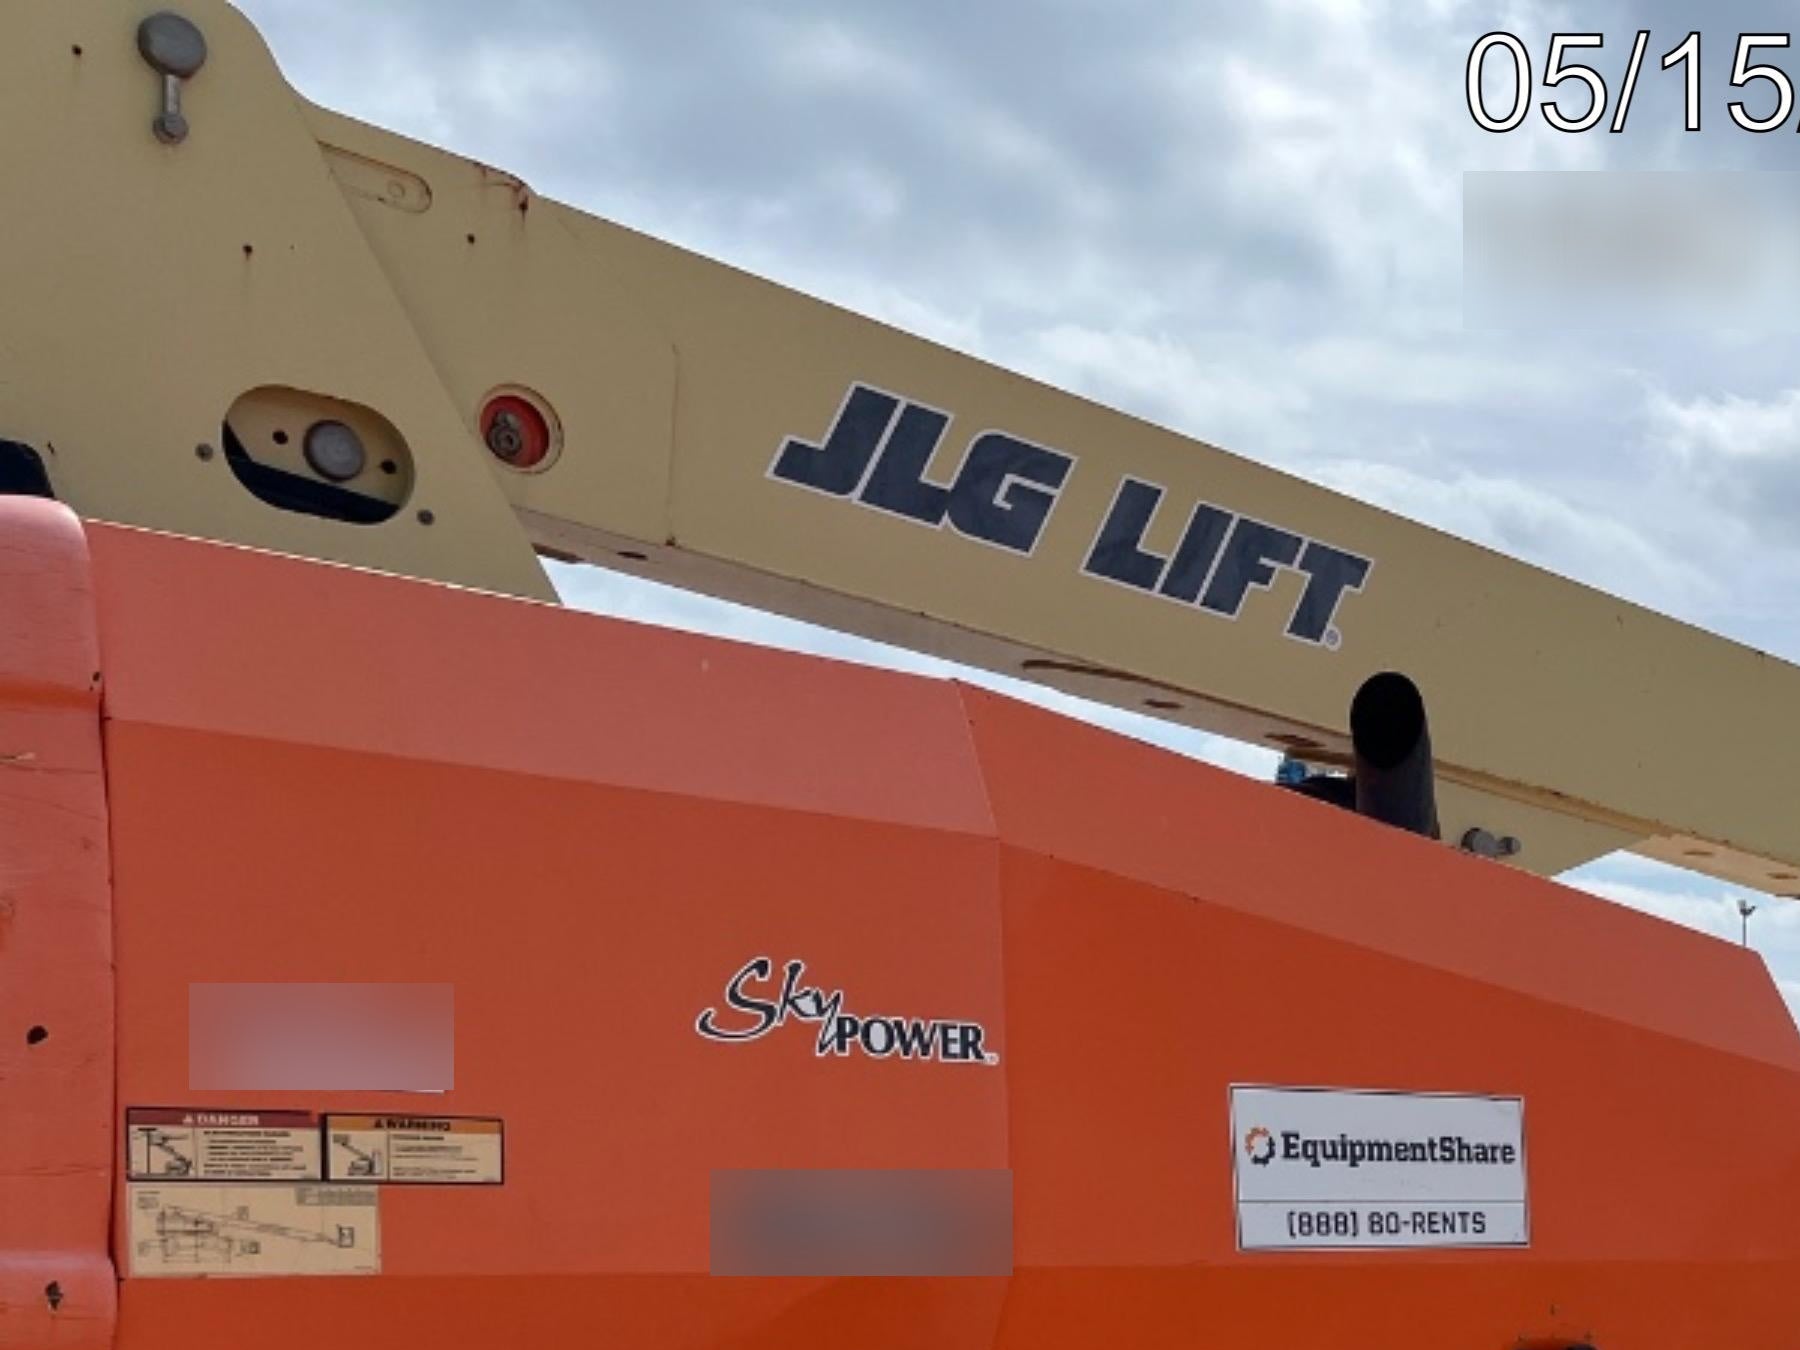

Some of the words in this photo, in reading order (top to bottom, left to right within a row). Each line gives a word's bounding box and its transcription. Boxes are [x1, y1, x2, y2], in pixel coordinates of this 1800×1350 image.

[765, 381, 1079, 557] JLG
[1080, 474, 1375, 646] LIFT
[695, 957, 842, 1056] Sky
[197, 1113, 259, 1126] DANGER
[1281, 1131, 1516, 1167] EquipmentShare
[1368, 1211, 1486, 1235] 80-RENTS
